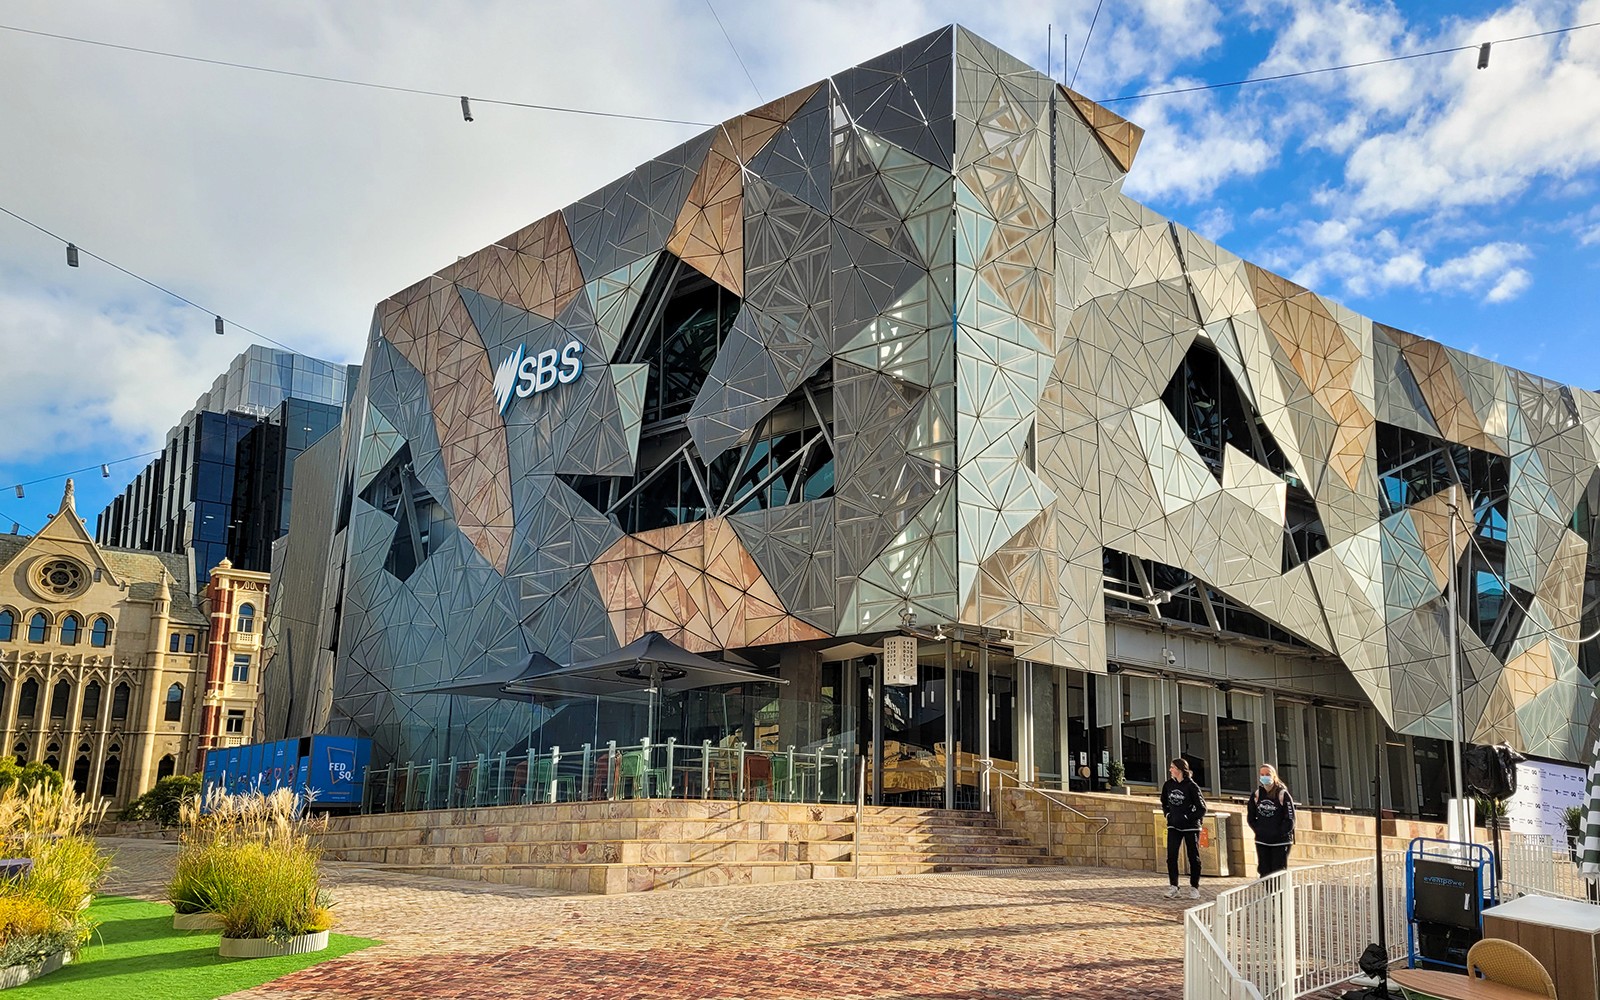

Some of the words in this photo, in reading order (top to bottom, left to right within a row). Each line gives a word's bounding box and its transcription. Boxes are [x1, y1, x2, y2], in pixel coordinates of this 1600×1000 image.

[516, 341, 584, 398] SBS
[328, 762, 346, 771] FED
[338, 771, 353, 781] SQ.
